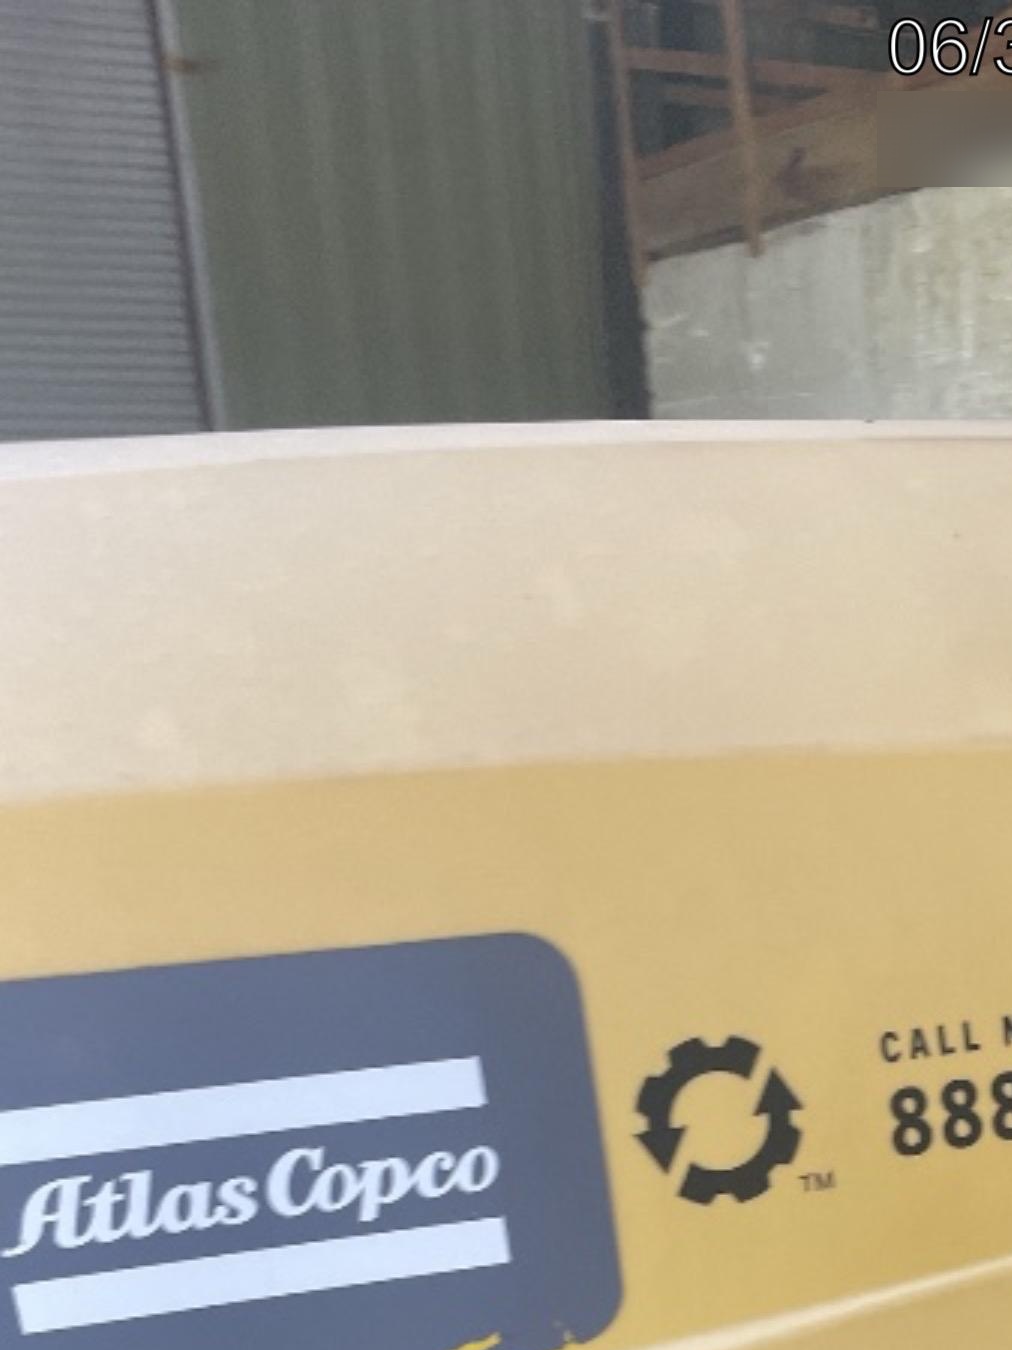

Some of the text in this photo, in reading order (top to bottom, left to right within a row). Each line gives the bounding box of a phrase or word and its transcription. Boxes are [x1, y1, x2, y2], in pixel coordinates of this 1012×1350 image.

[880, 1019, 982, 1064] CALL
[1, 1145, 502, 1258] Atlas Copco
